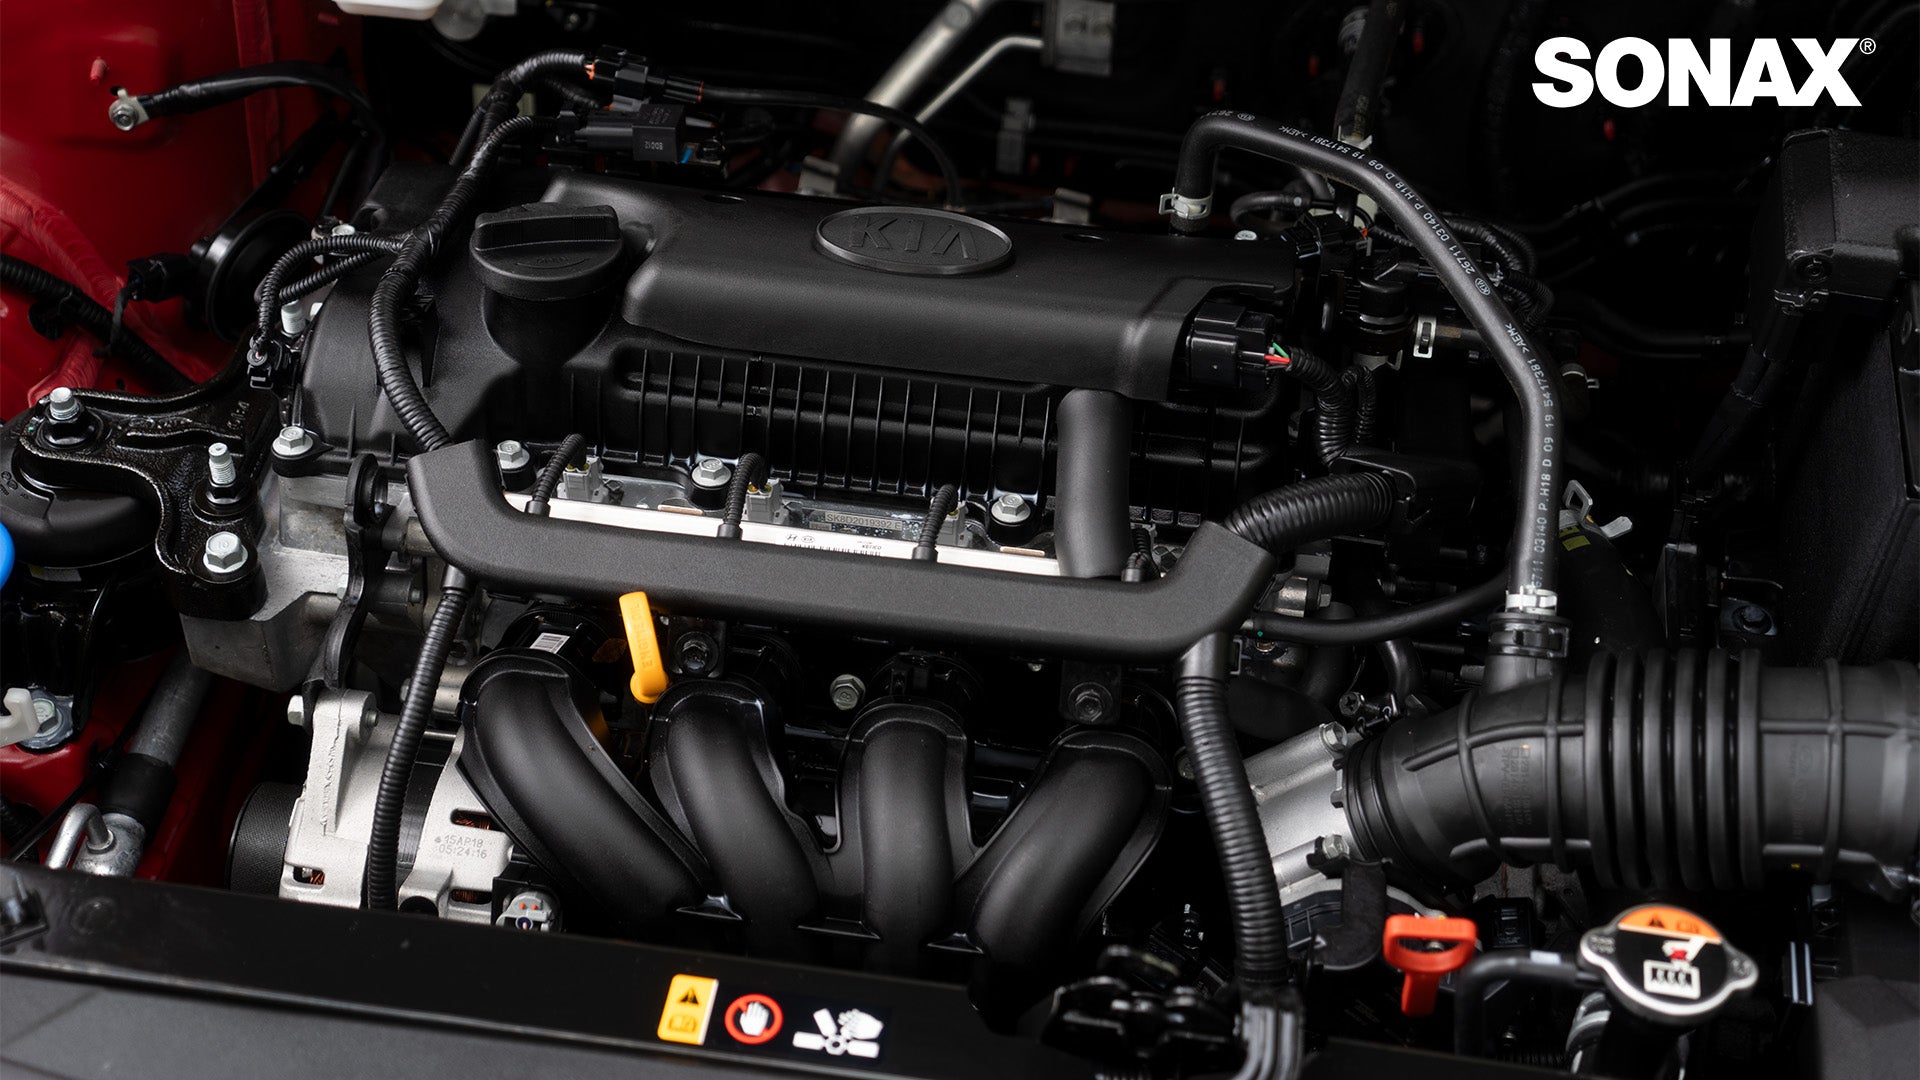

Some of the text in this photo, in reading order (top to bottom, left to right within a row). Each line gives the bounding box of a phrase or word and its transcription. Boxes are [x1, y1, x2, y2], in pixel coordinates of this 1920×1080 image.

[1310, 135, 1351, 154] 5417381
[1352, 151, 1365, 159] 19
[1368, 159, 1384, 170] 09
[1385, 171, 1395, 180] D
[1423, 212, 1450, 241] 03140
[1449, 245, 1475, 274] 26711
[1475, 278, 1491, 295] KIA
[1527, 358, 1554, 407] 5417381
[1544, 414, 1554, 428] 19
[1543, 436, 1554, 452] 09
[1542, 459, 1552, 467] D
[826, 513, 891, 529] SK8D2019392
[1534, 517, 1547, 553] 03140
[1531, 560, 1544, 588] 6711
